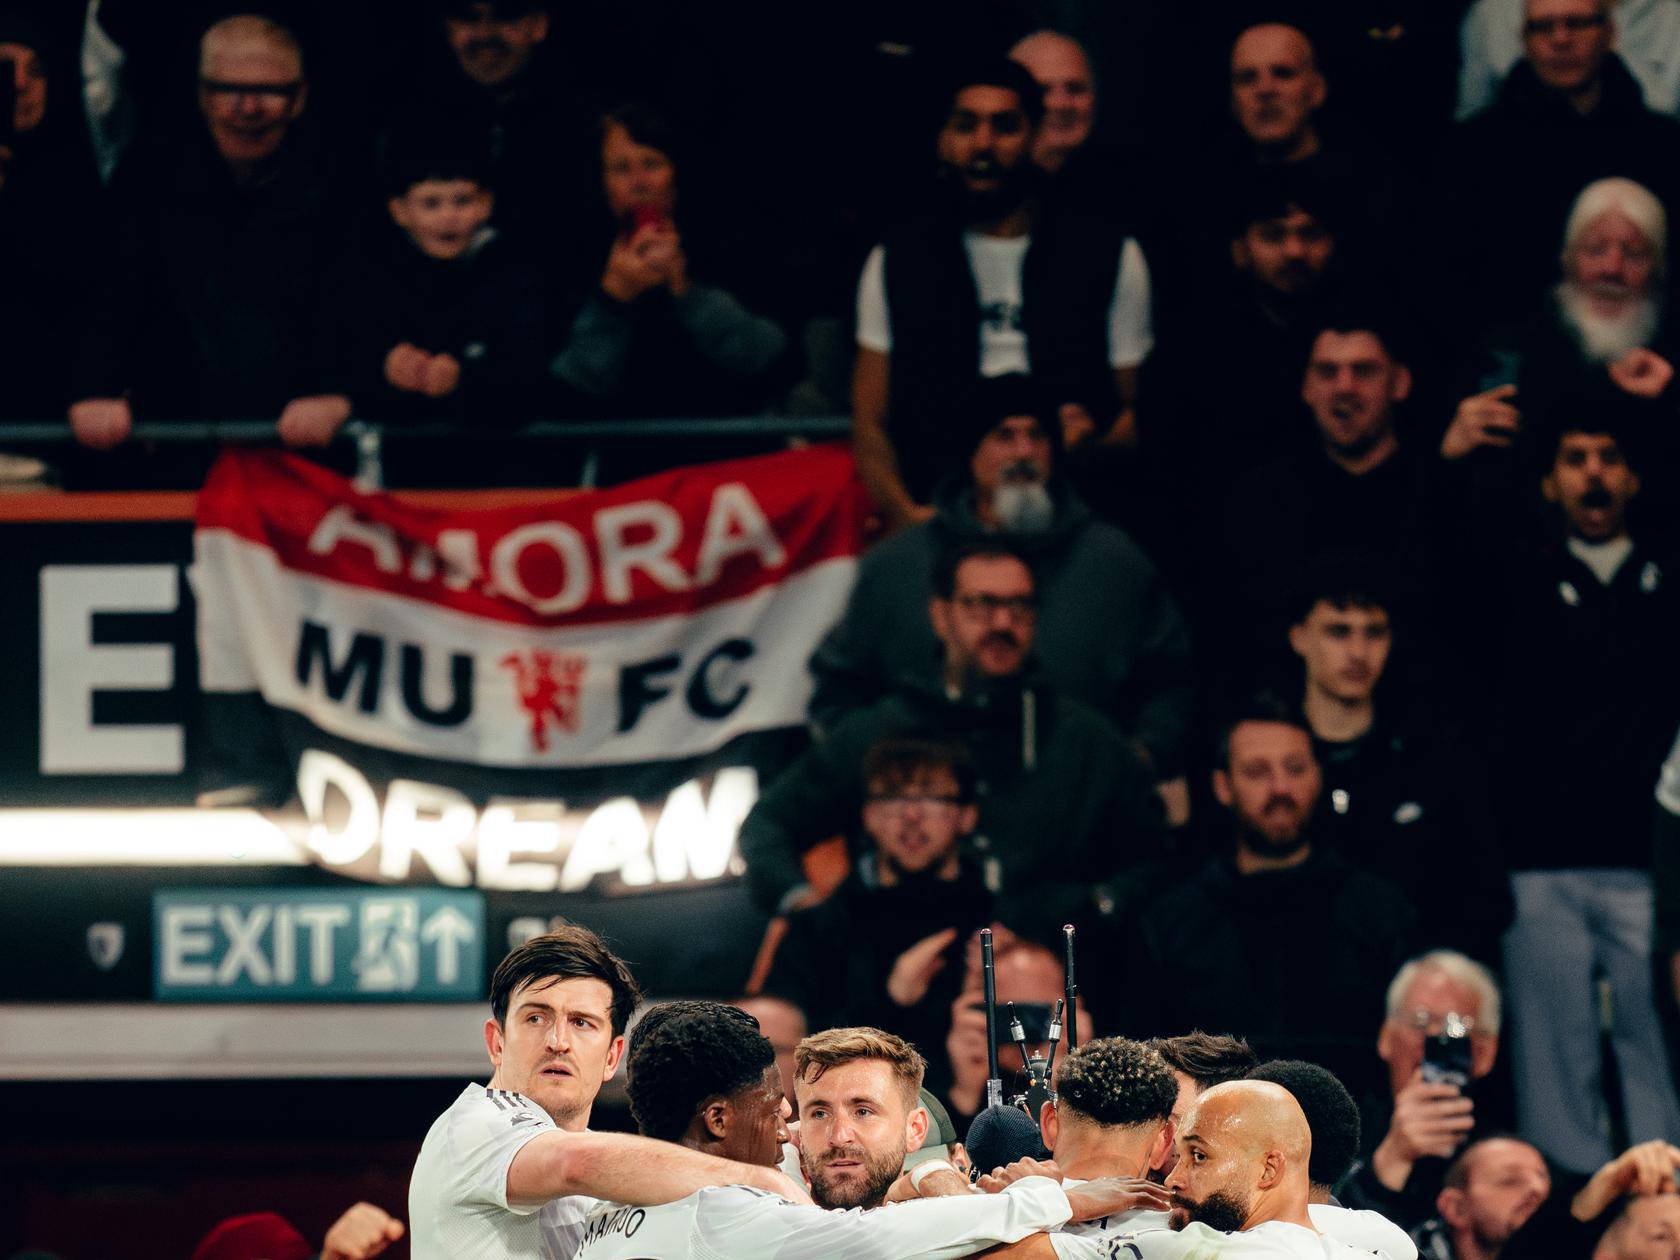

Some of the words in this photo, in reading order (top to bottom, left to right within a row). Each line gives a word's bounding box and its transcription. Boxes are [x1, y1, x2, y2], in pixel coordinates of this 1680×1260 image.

[296, 620, 474, 728] MU
[617, 637, 754, 733] FC
[161, 905, 351, 986] EXIT
